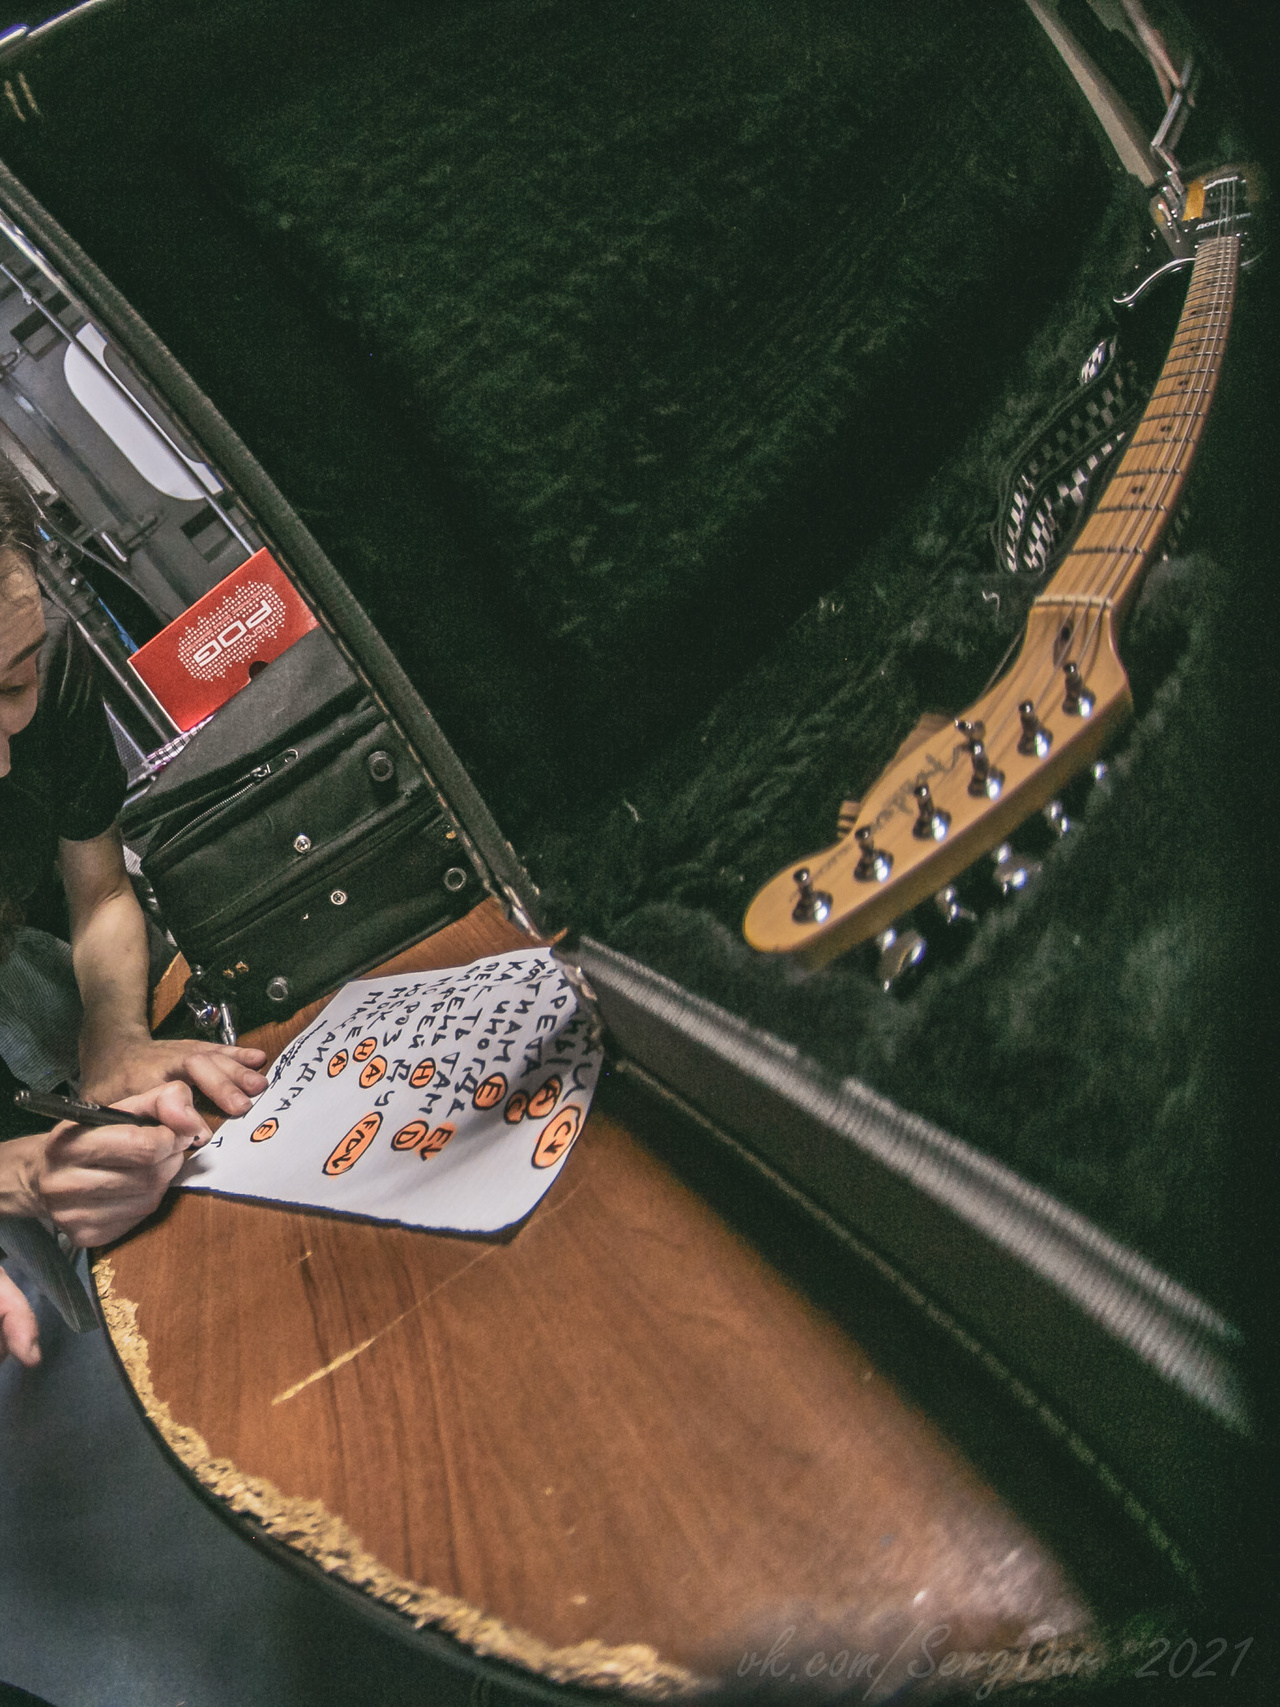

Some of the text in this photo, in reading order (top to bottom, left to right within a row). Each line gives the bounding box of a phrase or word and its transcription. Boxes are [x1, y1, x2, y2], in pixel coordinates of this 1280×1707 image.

[193, 600, 272, 667] POG
[243, 616, 275, 642] micro
[520, 978, 569, 1078] АРЕТА
